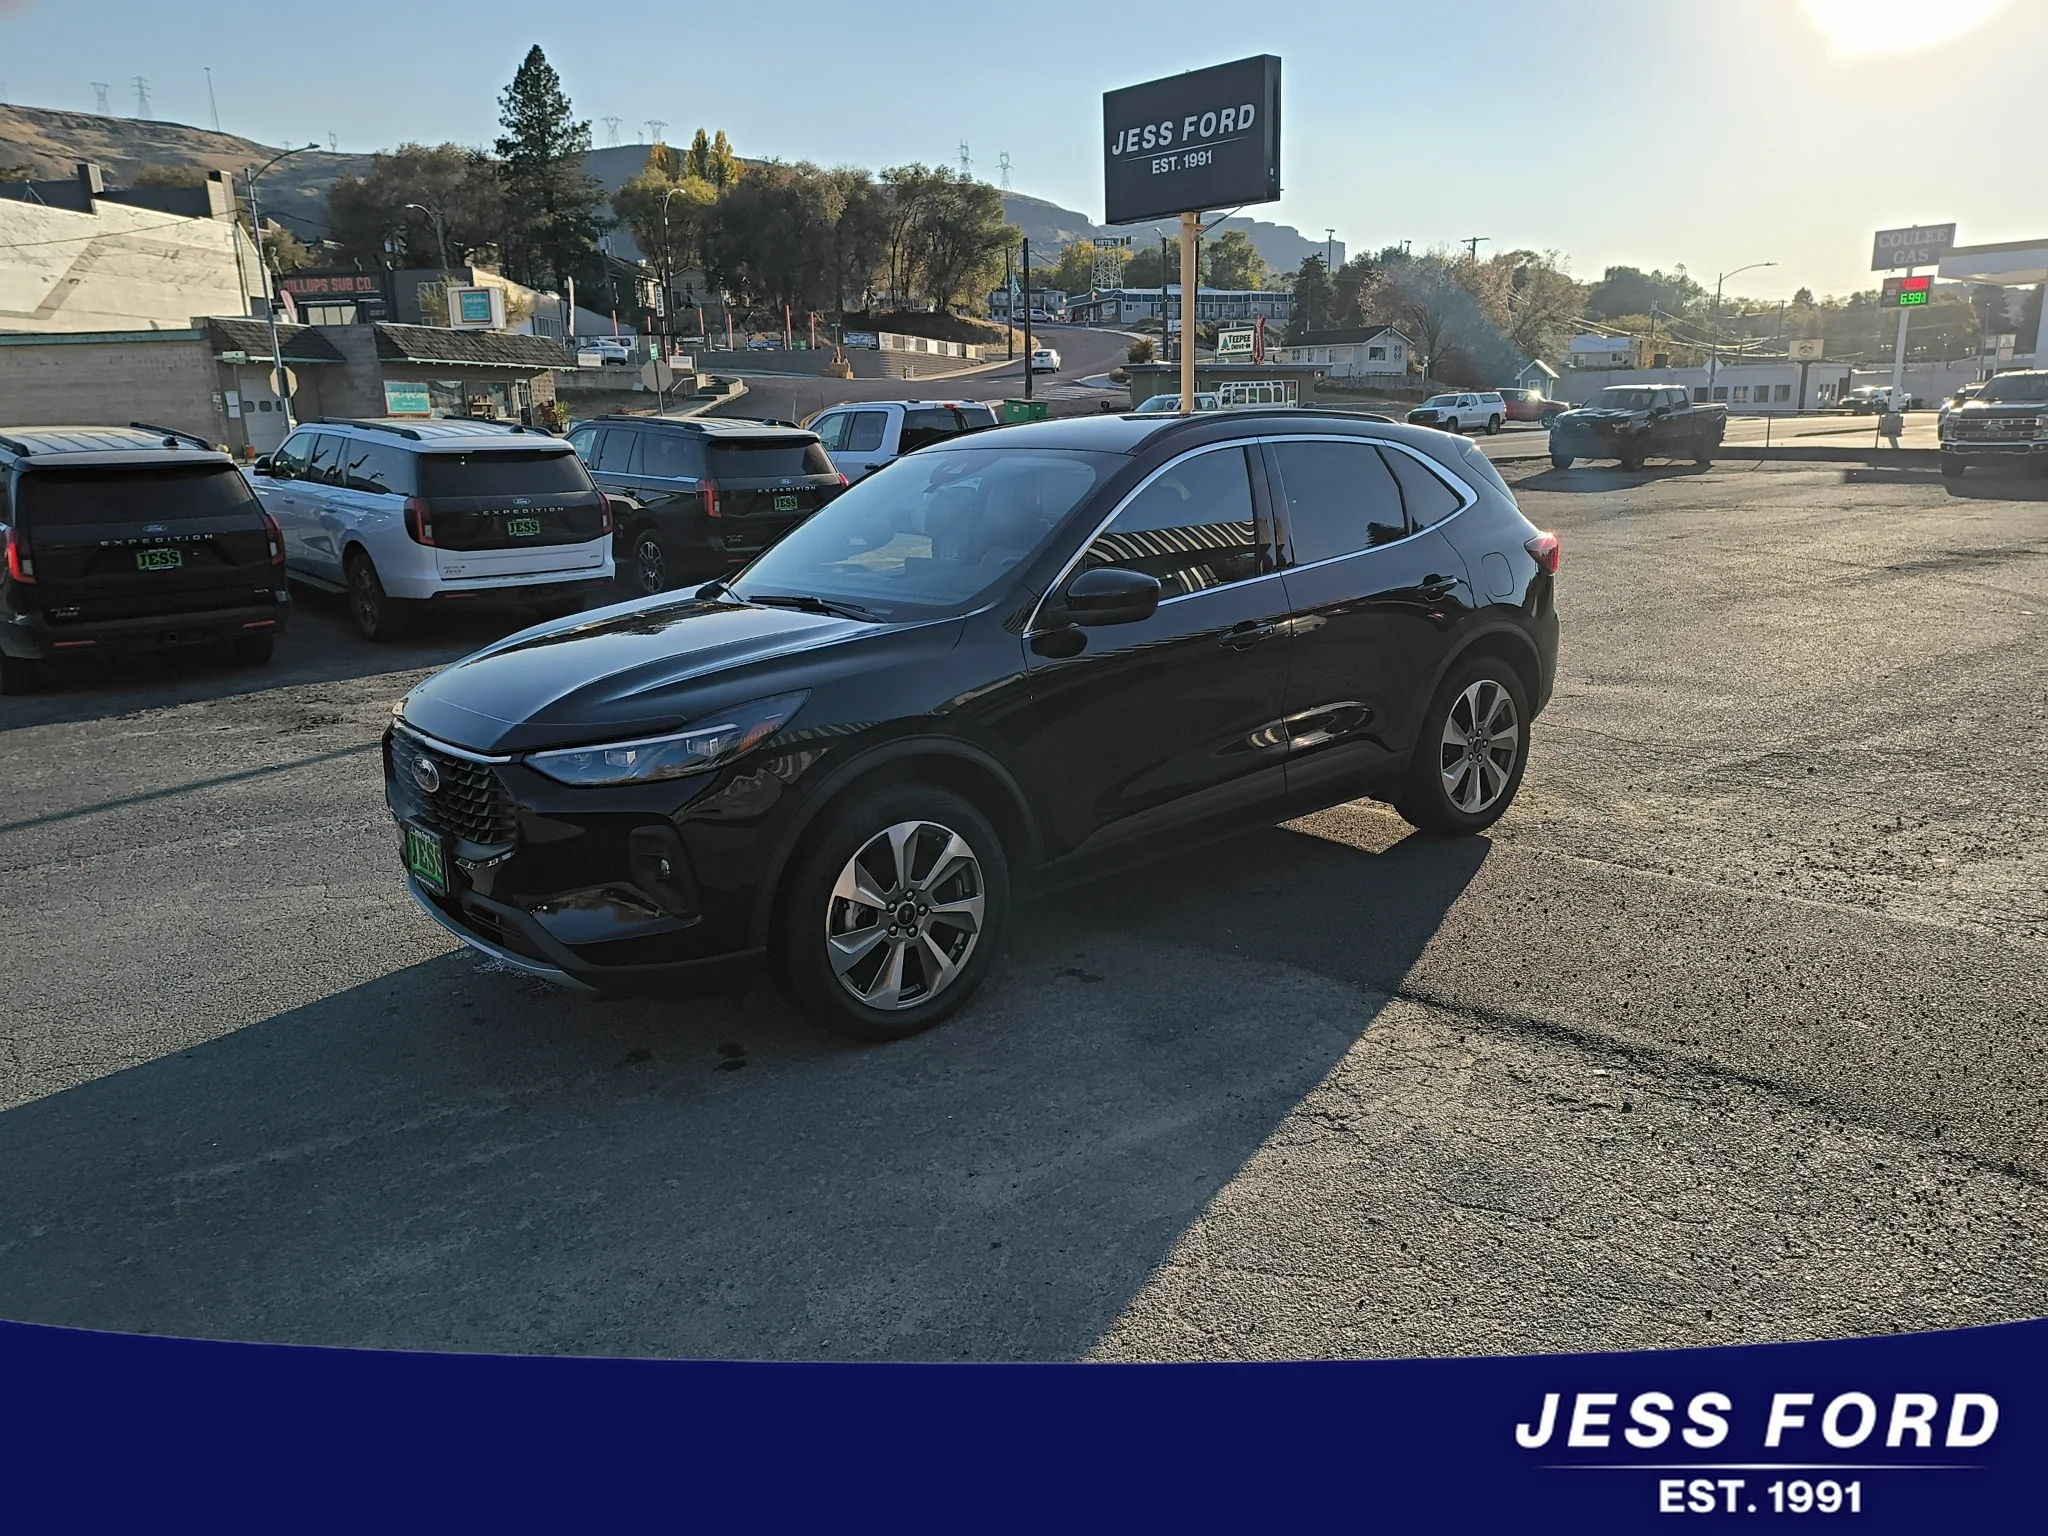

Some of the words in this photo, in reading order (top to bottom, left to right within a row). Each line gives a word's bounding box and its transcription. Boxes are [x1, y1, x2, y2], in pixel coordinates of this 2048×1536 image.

[1111, 121, 1174, 156] JESS
[1182, 103, 1256, 142] FORD
[1152, 156, 1181, 174] EST.
[1183, 150, 1213, 168] 1991
[1878, 227, 1948, 248] COULEE
[1893, 248, 1929, 264] GAS
[331, 277, 353, 291] SUB
[356, 276, 375, 290] CO.
[1228, 334, 1251, 344] TEEPEE
[774, 497, 797, 508] JESS
[482, 506, 565, 516] EXPEDITION
[509, 521, 539, 534] JESS
[100, 533, 213, 547] EXPEDITION
[138, 551, 181, 567] JESS
